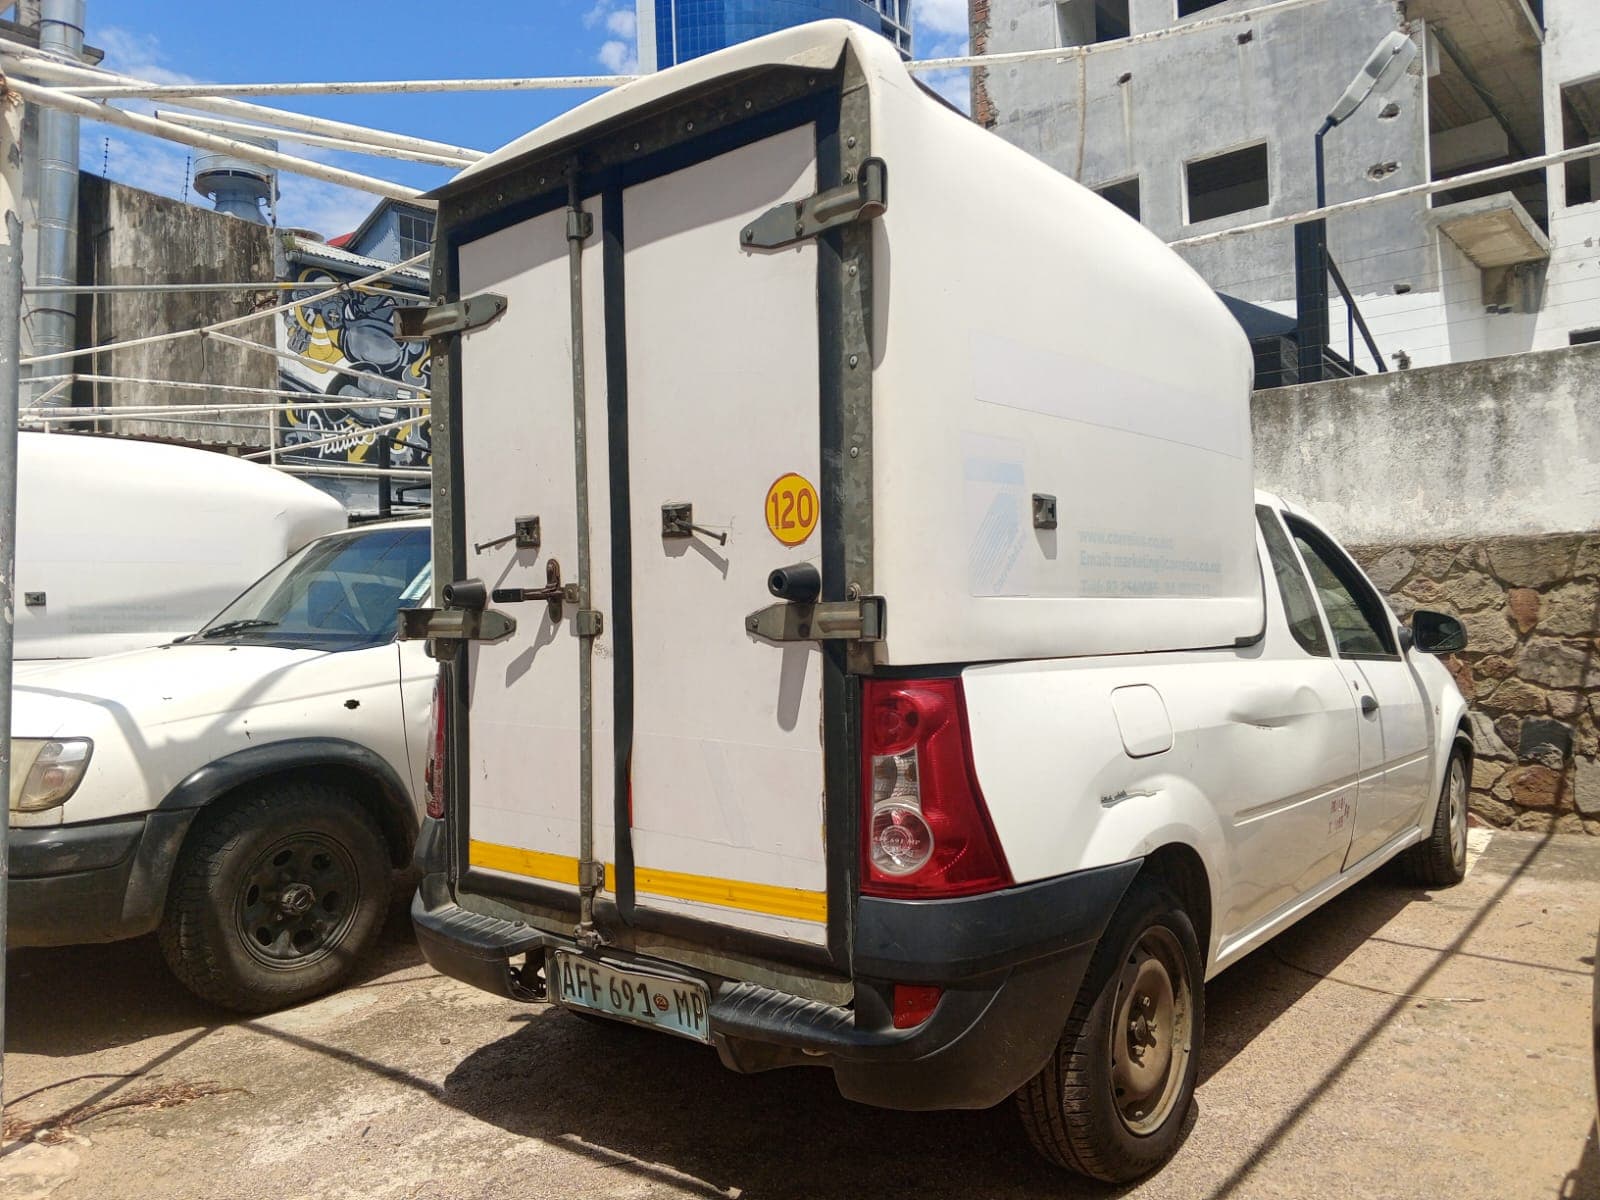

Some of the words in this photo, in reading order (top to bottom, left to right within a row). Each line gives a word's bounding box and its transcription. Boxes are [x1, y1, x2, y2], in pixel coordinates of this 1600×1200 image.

[771, 487, 813, 530] 120
[563, 961, 602, 1002] AFF
[609, 977, 656, 1018] 691
[674, 989, 705, 1031] MP
